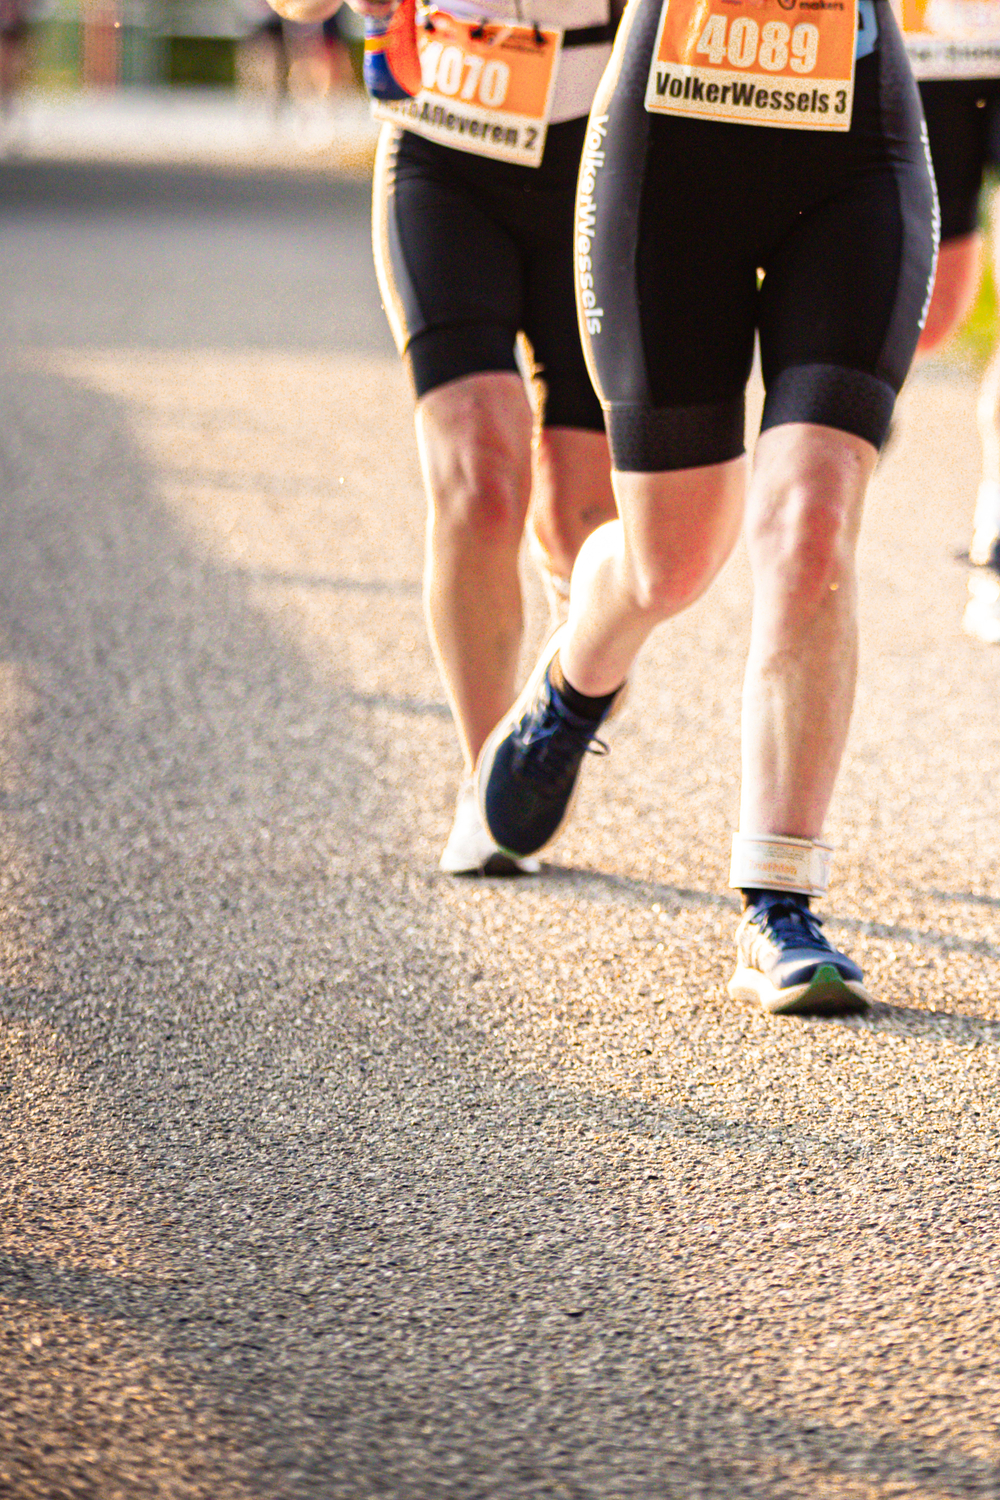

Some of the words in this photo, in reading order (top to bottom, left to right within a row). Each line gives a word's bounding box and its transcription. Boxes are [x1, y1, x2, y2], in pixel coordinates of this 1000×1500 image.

[697, 14, 820, 74] 4089
[656, 72, 830, 114] VolkerWessels
[835, 90, 848, 115] 3
[525, 126, 538, 150] 2
[577, 113, 610, 336] VolkerWessels
